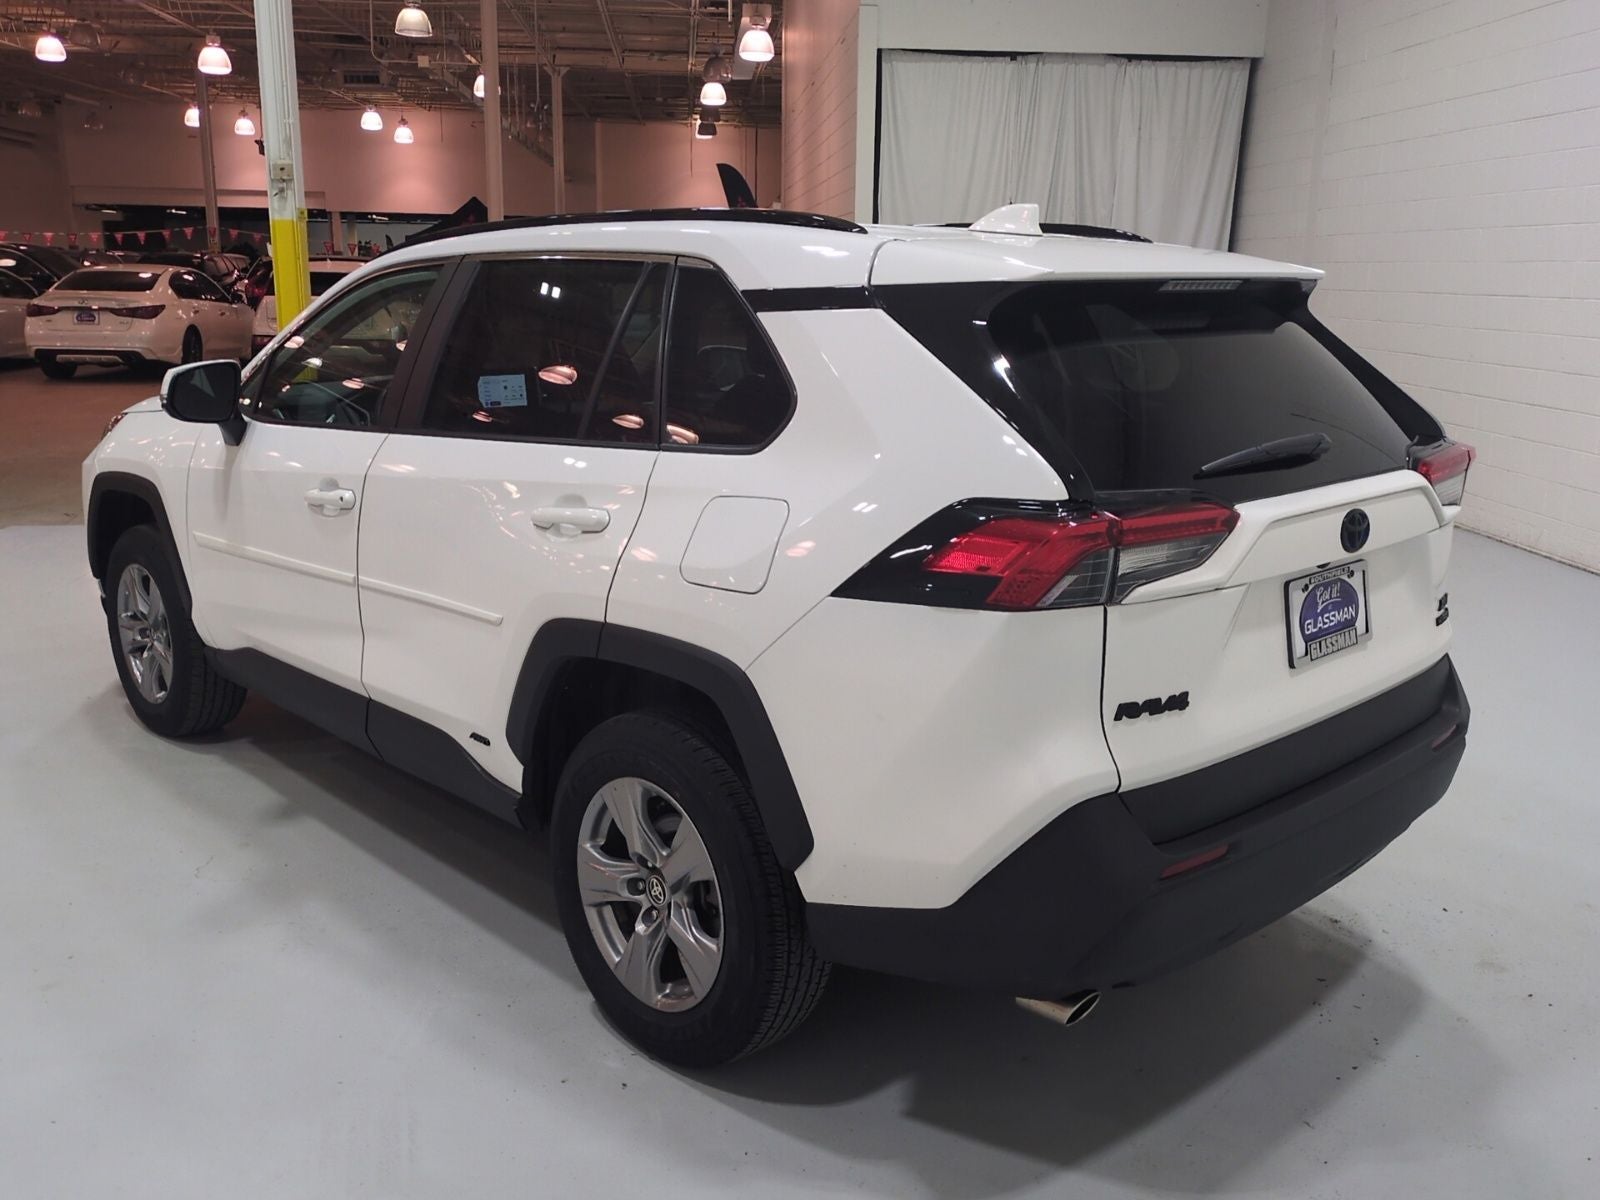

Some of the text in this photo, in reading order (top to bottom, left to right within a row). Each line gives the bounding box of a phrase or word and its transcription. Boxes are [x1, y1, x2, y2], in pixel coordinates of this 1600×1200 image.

[1316, 585, 1331, 605] Got
[1304, 604, 1356, 635] GLASSMAN
[1310, 629, 1357, 660] GLASSMAN
